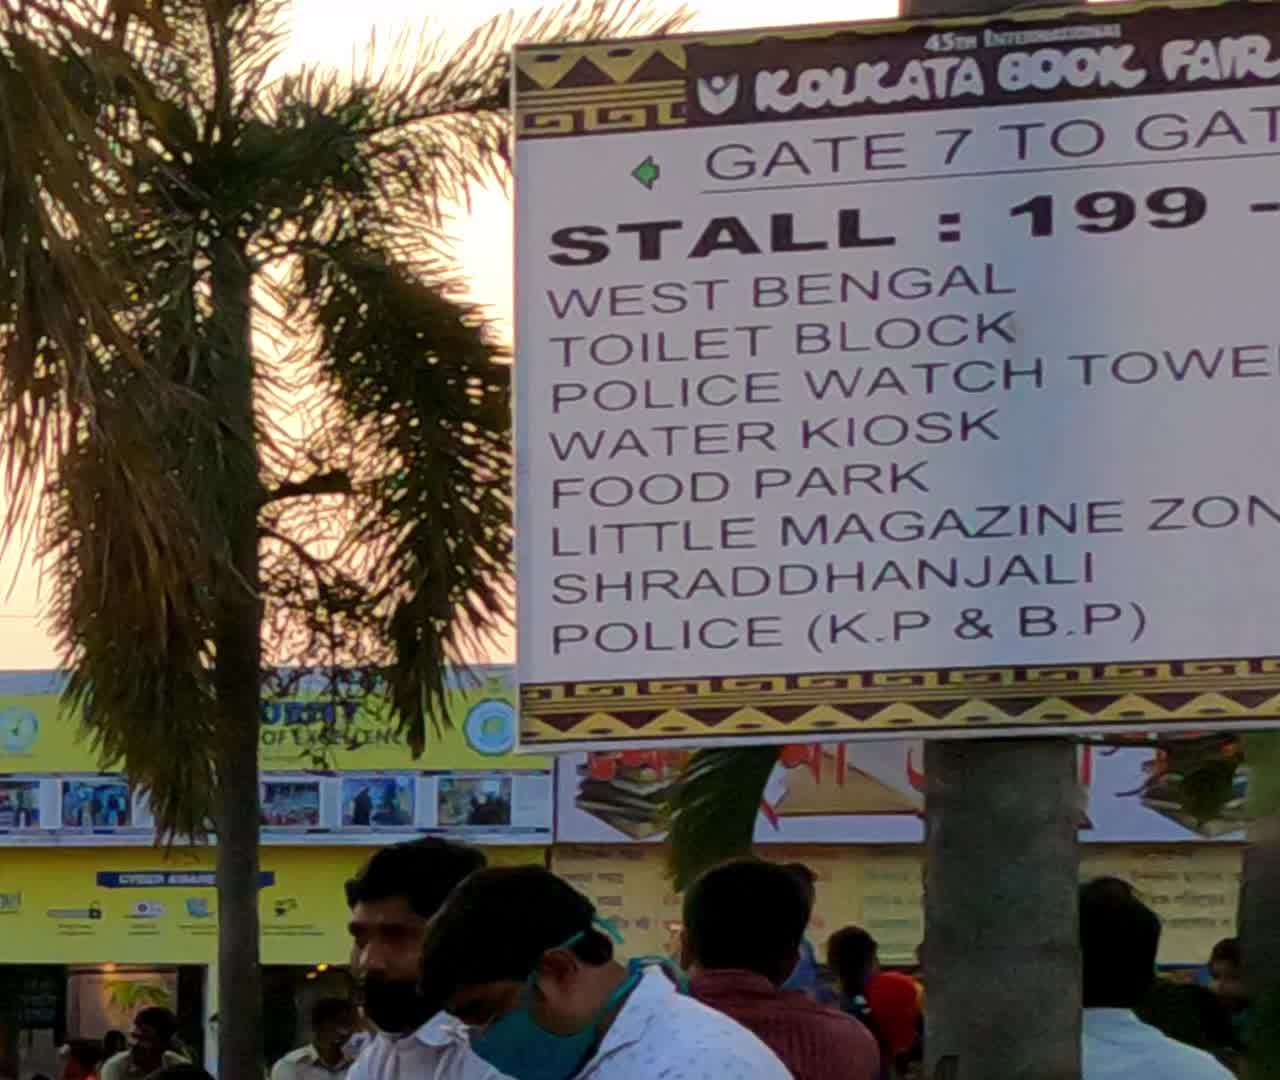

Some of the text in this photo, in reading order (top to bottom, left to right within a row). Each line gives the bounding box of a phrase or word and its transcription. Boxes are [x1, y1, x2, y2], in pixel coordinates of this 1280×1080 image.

[754, 34, 1280, 113] KOLKATA BOOK FAIR
[704, 131, 909, 181] GATE
[936, 128, 973, 165] 7
[999, 119, 1106, 159] TO
[548, 208, 896, 267] STALL
[1008, 186, 1208, 237] 199
[546, 263, 1016, 320] WEST BENGAL
[549, 311, 1016, 368] TOILET BLOCK
[552, 344, 1280, 414] POLICE WATCH TOWE
[548, 408, 1000, 462] WATER KIOSK
[552, 460, 930, 509] FOOD PARK
[552, 517, 757, 557] LITTLE
[781, 499, 1124, 547] MAGAZINE
[552, 551, 1096, 605] SHRADDHANJALI
[552, 601, 1146, 656] POLICE (K.P & B.P)
